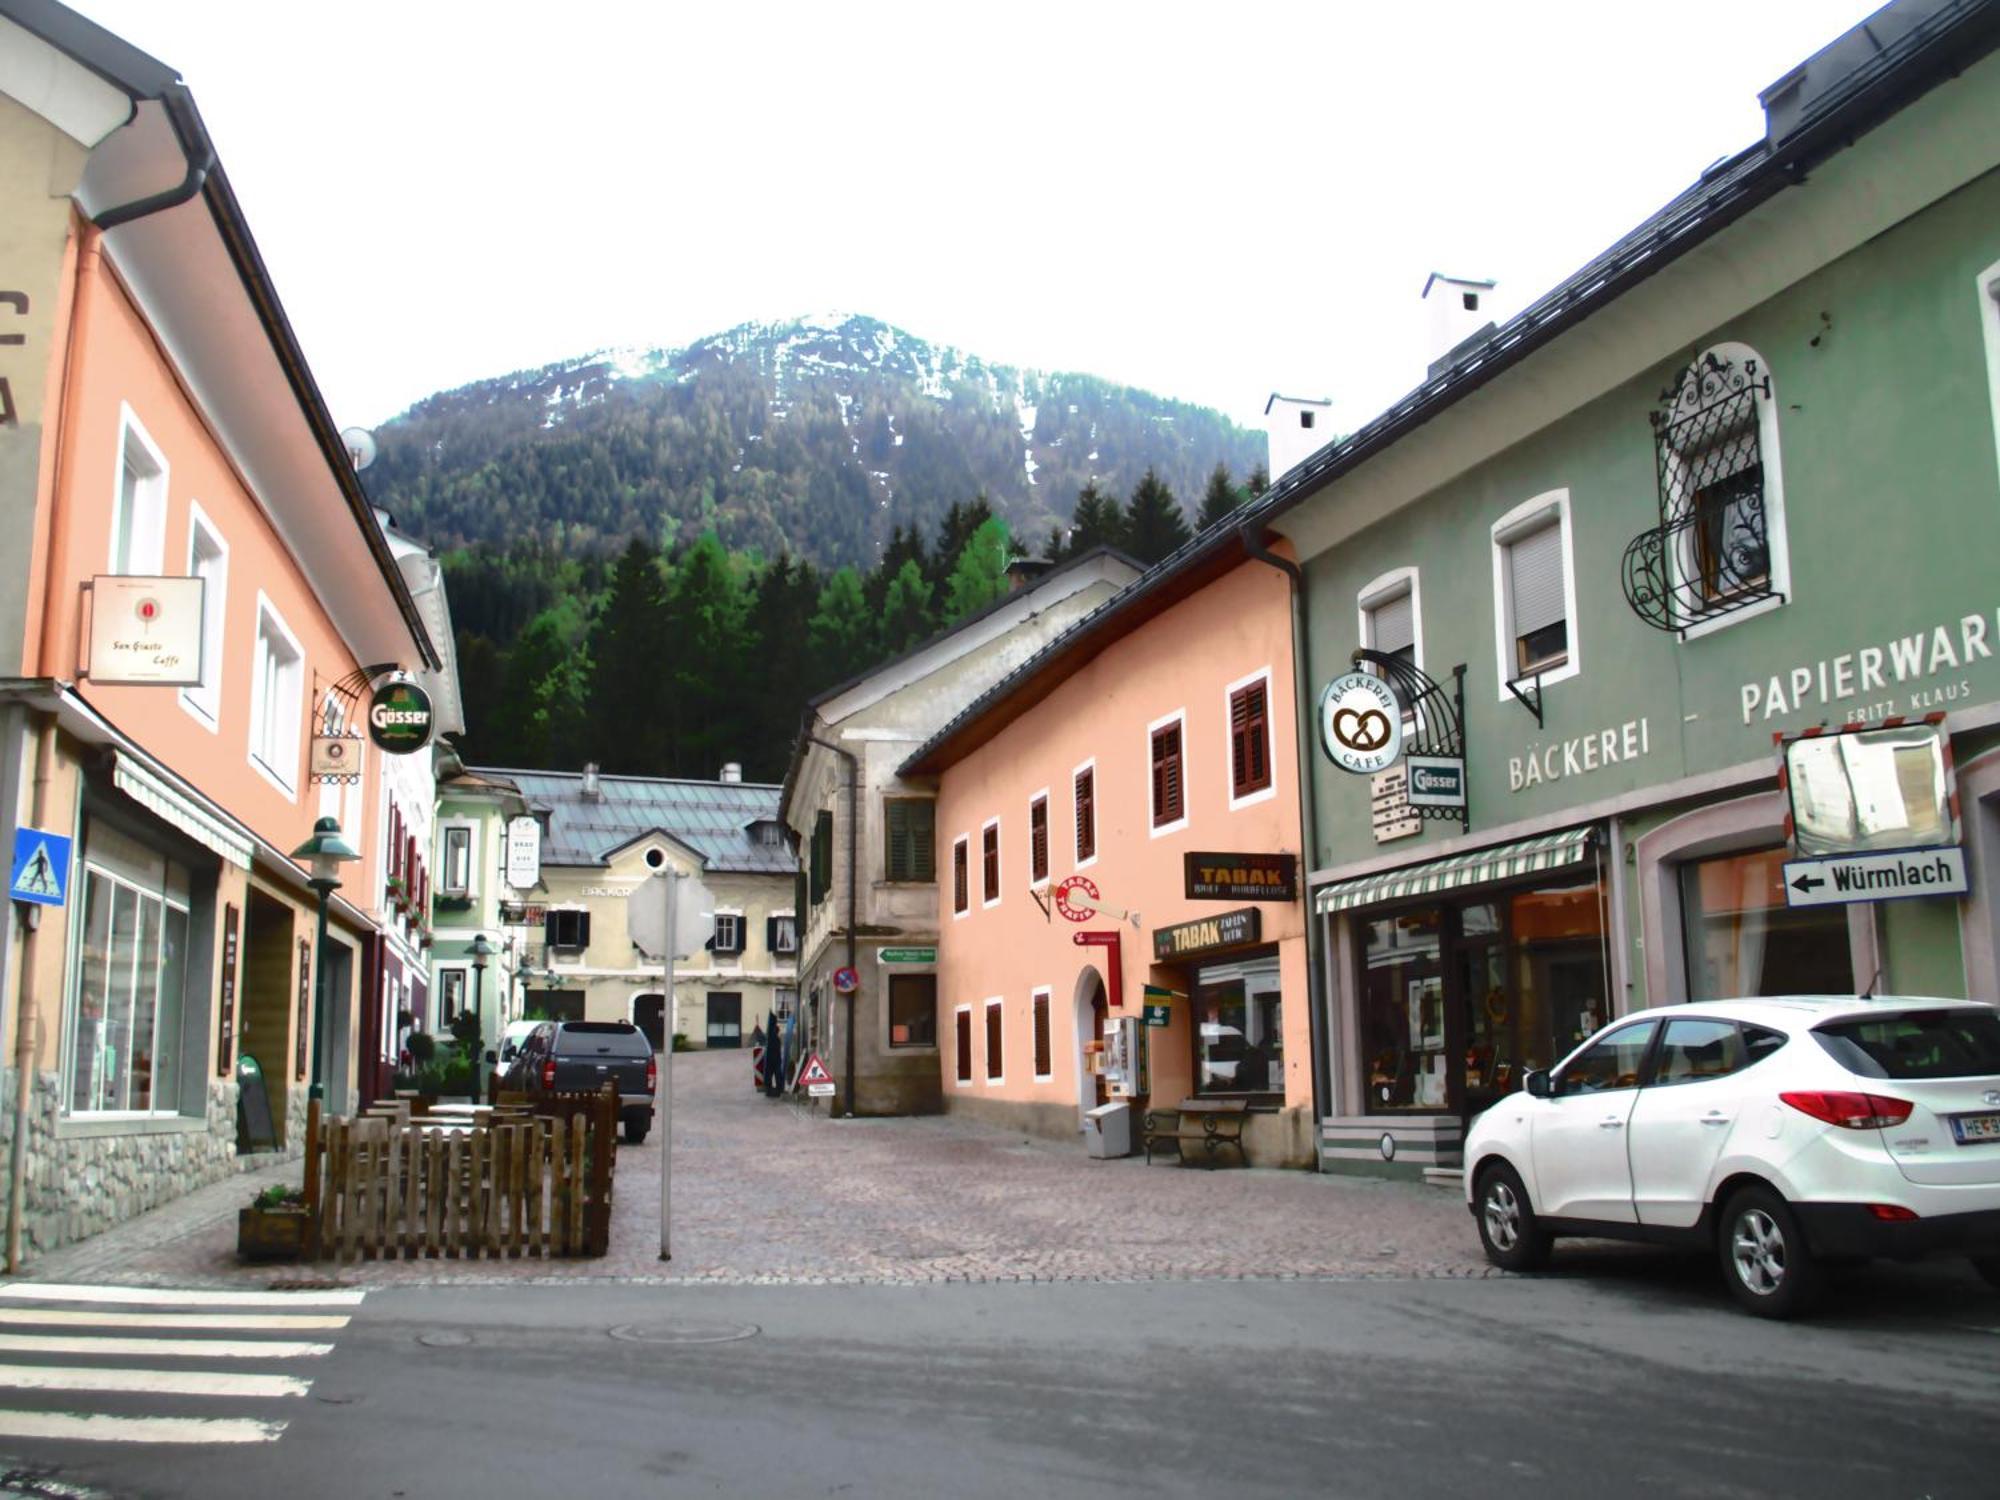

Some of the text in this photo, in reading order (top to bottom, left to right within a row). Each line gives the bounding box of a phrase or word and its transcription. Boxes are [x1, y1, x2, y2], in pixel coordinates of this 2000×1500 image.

[1741, 607, 2000, 726] PAPIERWAR
[371, 703, 429, 728] Gösser
[1847, 681, 1970, 724] FRITZ KLAUS
[1509, 718, 1649, 792] BÄCKEREI
[1414, 768, 1457, 791] Gösser
[1061, 877, 1097, 897] TABAK
[1200, 868, 1280, 884] TABAK
[1832, 857, 1952, 891] Würmlach
[1173, 921, 1220, 951] TABAK
